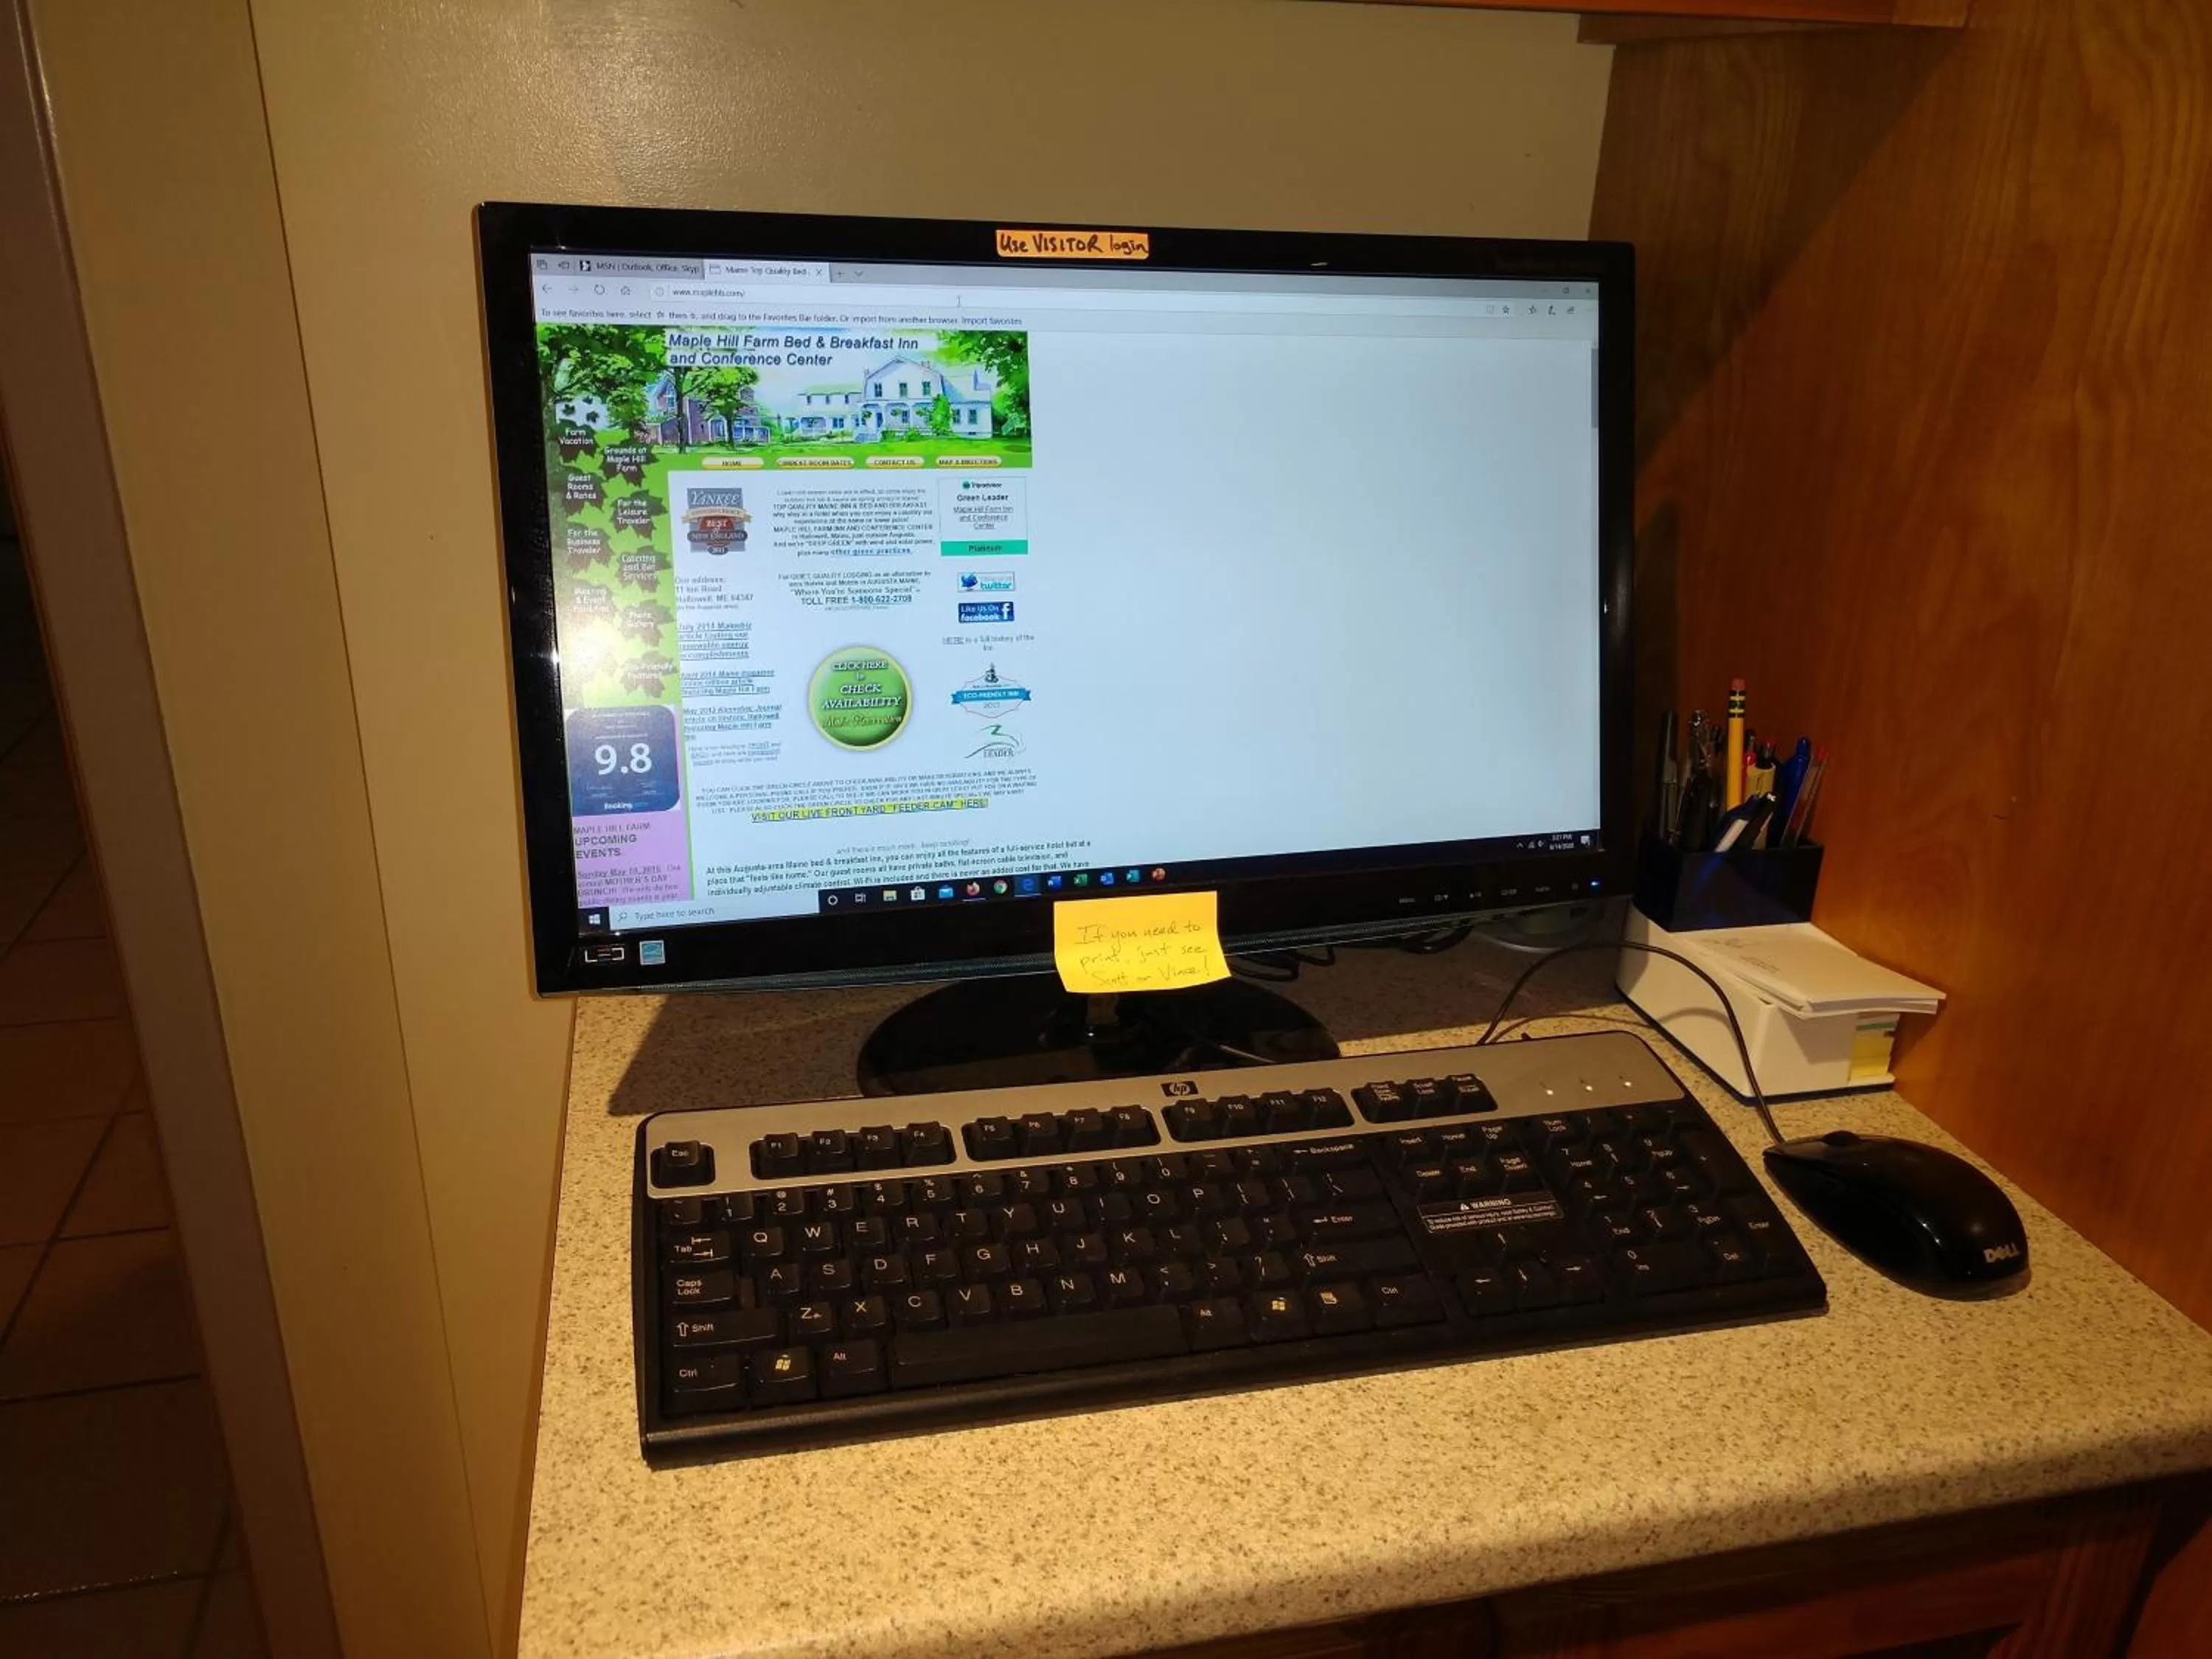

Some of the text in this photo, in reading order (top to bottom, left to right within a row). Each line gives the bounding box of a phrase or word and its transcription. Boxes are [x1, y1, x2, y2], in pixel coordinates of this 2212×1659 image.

[1000, 233, 1149, 254] Use VISITOR login
[596, 263, 615, 271] MSN
[718, 313, 736, 323] drag
[669, 334, 918, 350] Maple Hill Farm Bed & Breakfast Inn
[670, 352, 832, 366] and Conference Center
[566, 428, 585, 437] Farm
[559, 437, 593, 445] Vacation
[605, 446, 638, 454] Grounds
[607, 455, 630, 464] Maple
[616, 464, 637, 473] Farm
[568, 474, 591, 482] Guest
[567, 483, 594, 491] Rooms
[957, 493, 1009, 502] Green Leader
[618, 507, 647, 515] Leisure
[617, 516, 650, 525] Traveler
[567, 538, 600, 546] Business
[567, 546, 602, 554] Traveler
[980, 581, 1012, 590] twitter
[801, 597, 823, 605] TOLL
[826, 596, 848, 605] FREE
[960, 613, 1000, 622] facebook
[840, 684, 882, 694] CHECK
[822, 696, 902, 709] AVAILABILITY
[594, 742, 653, 776] 9.8
[751, 812, 776, 821] VISIT
[779, 810, 799, 820] OUR
[800, 809, 824, 818] LIVE
[826, 807, 858, 818] FRONT
[861, 804, 884, 814] YARD
[574, 834, 638, 846] UPCOMING
[575, 848, 622, 859] EVENTS
[634, 911, 654, 921] Type
[688, 907, 714, 916] search
[1111, 929, 1137, 953] you
[1144, 921, 1179, 936] need
[1184, 919, 1202, 932] to
[1137, 942, 1170, 963] just
[1172, 1081, 1189, 1096] hp
[1116, 1172, 1125, 1181] 9
[1161, 1168, 1171, 1178] 0
[1023, 1180, 1030, 1189] 7
[1069, 1176, 1079, 1186] 8
[926, 1189, 936, 1199] 5
[975, 1185, 984, 1194] 6
[1192, 1187, 1204, 1198] P
[828, 1199, 837, 1209] 3
[877, 1194, 886, 1203] 4
[1099, 1197, 1105, 1208] I
[1147, 1193, 1161, 1204] O
[1470, 1198, 1512, 1209] WARNING
[727, 1208, 733, 1217] 1
[777, 1202, 787, 1212] 2
[1003, 1206, 1015, 1217] Y
[1051, 1203, 1065, 1214] U
[906, 1217, 919, 1228] R
[956, 1213, 967, 1223] T
[804, 1226, 821, 1239] W
[856, 1221, 869, 1233] E
[753, 1231, 768, 1244] Q
[1122, 1232, 1137, 1244] K
[1169, 1229, 1180, 1239] L
[675, 1245, 692, 1253] Tab
[1026, 1243, 1040, 1254] H
[1076, 1238, 1086, 1249] J
[977, 1248, 991, 1260] G
[1983, 1242, 2020, 1264] DELL
[874, 1259, 887, 1270] D
[925, 1254, 936, 1265] F
[771, 1268, 783, 1279] A
[822, 1264, 835, 1275] S
[676, 1279, 703, 1288] Caps
[1110, 1272, 1127, 1284] M
[1009, 1284, 1023, 1296] B
[1060, 1279, 1075, 1290] N
[678, 1287, 701, 1296] Lock
[959, 1288, 971, 1301] V
[908, 1295, 922, 1307] C
[855, 1301, 868, 1313] X
[800, 1307, 813, 1319] Z
[692, 1323, 714, 1332] Shift
[832, 1352, 847, 1360] Alt
[679, 1368, 698, 1377] Ctrl
